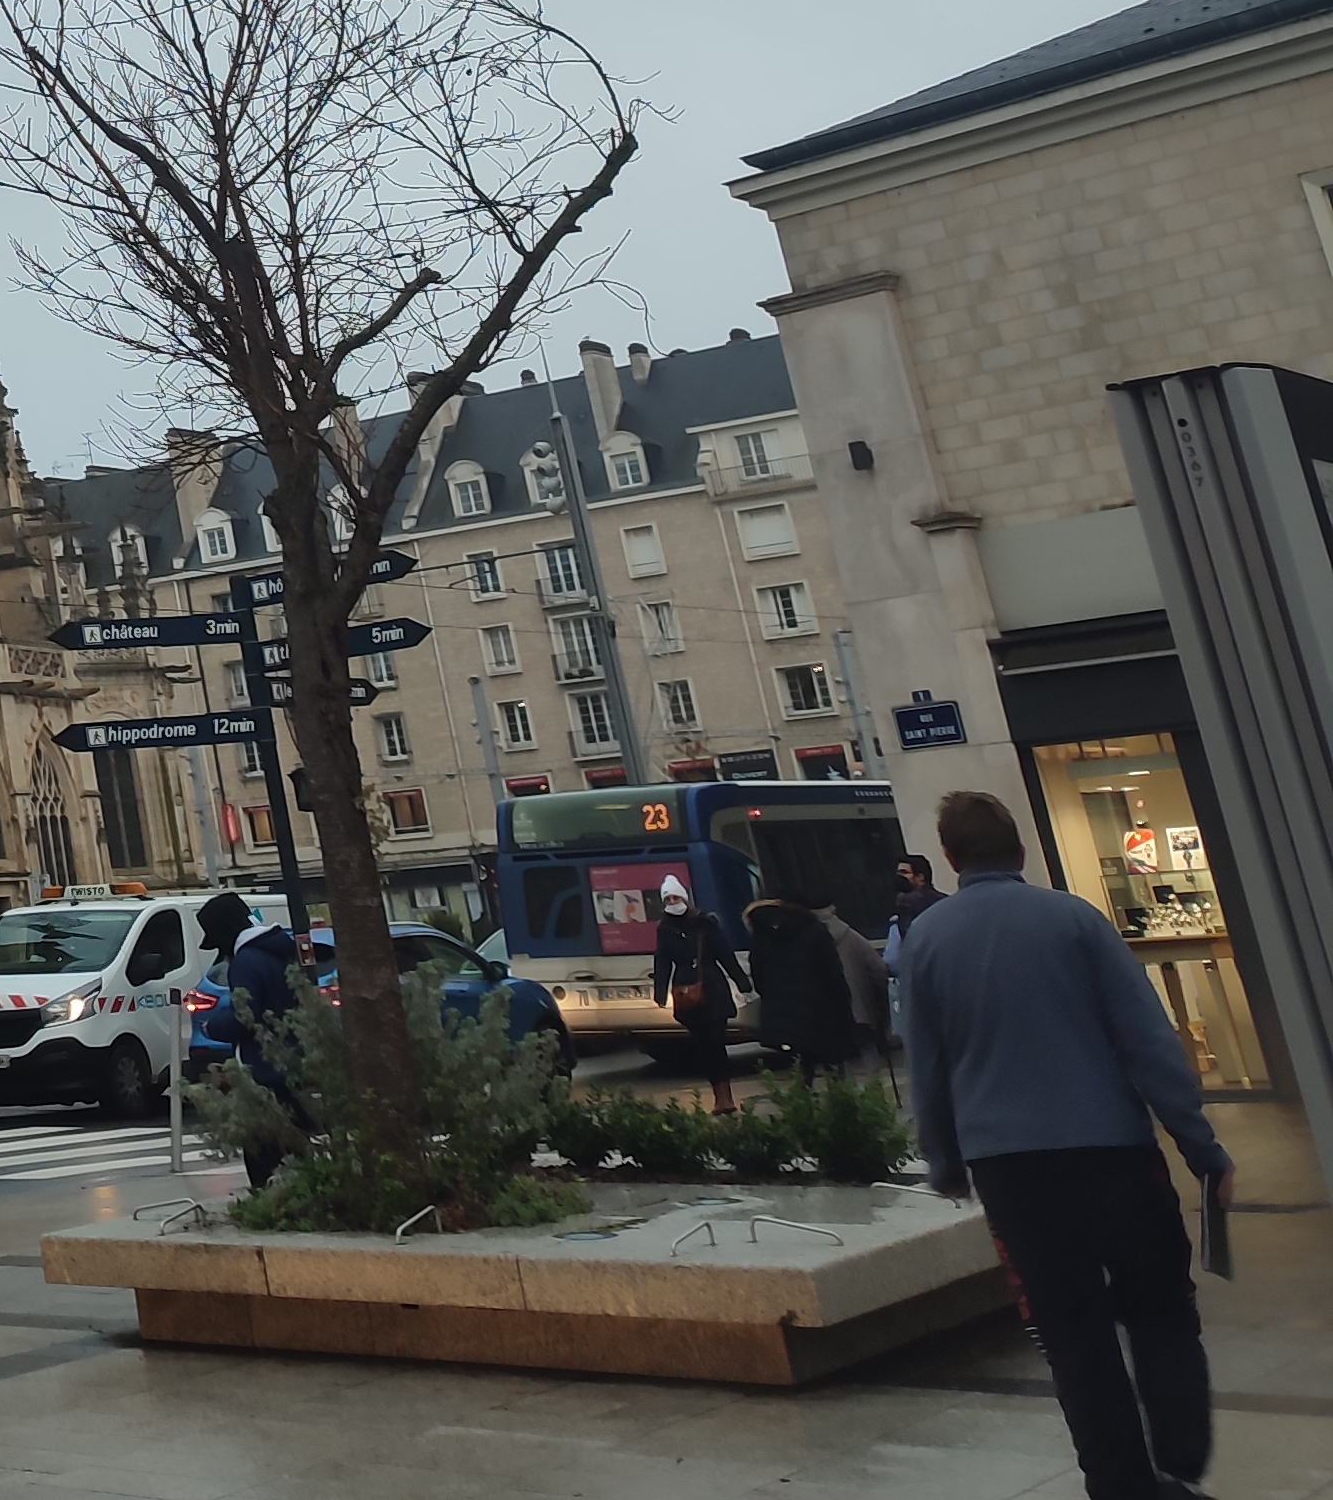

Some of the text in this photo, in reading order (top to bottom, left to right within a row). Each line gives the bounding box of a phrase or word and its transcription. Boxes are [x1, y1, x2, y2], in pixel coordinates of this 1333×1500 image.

[102, 619, 240, 640] château 3min
[371, 625, 405, 643] 5min
[108, 718, 255, 744] hippodrome 12min
[641, 803, 670, 831] 23
